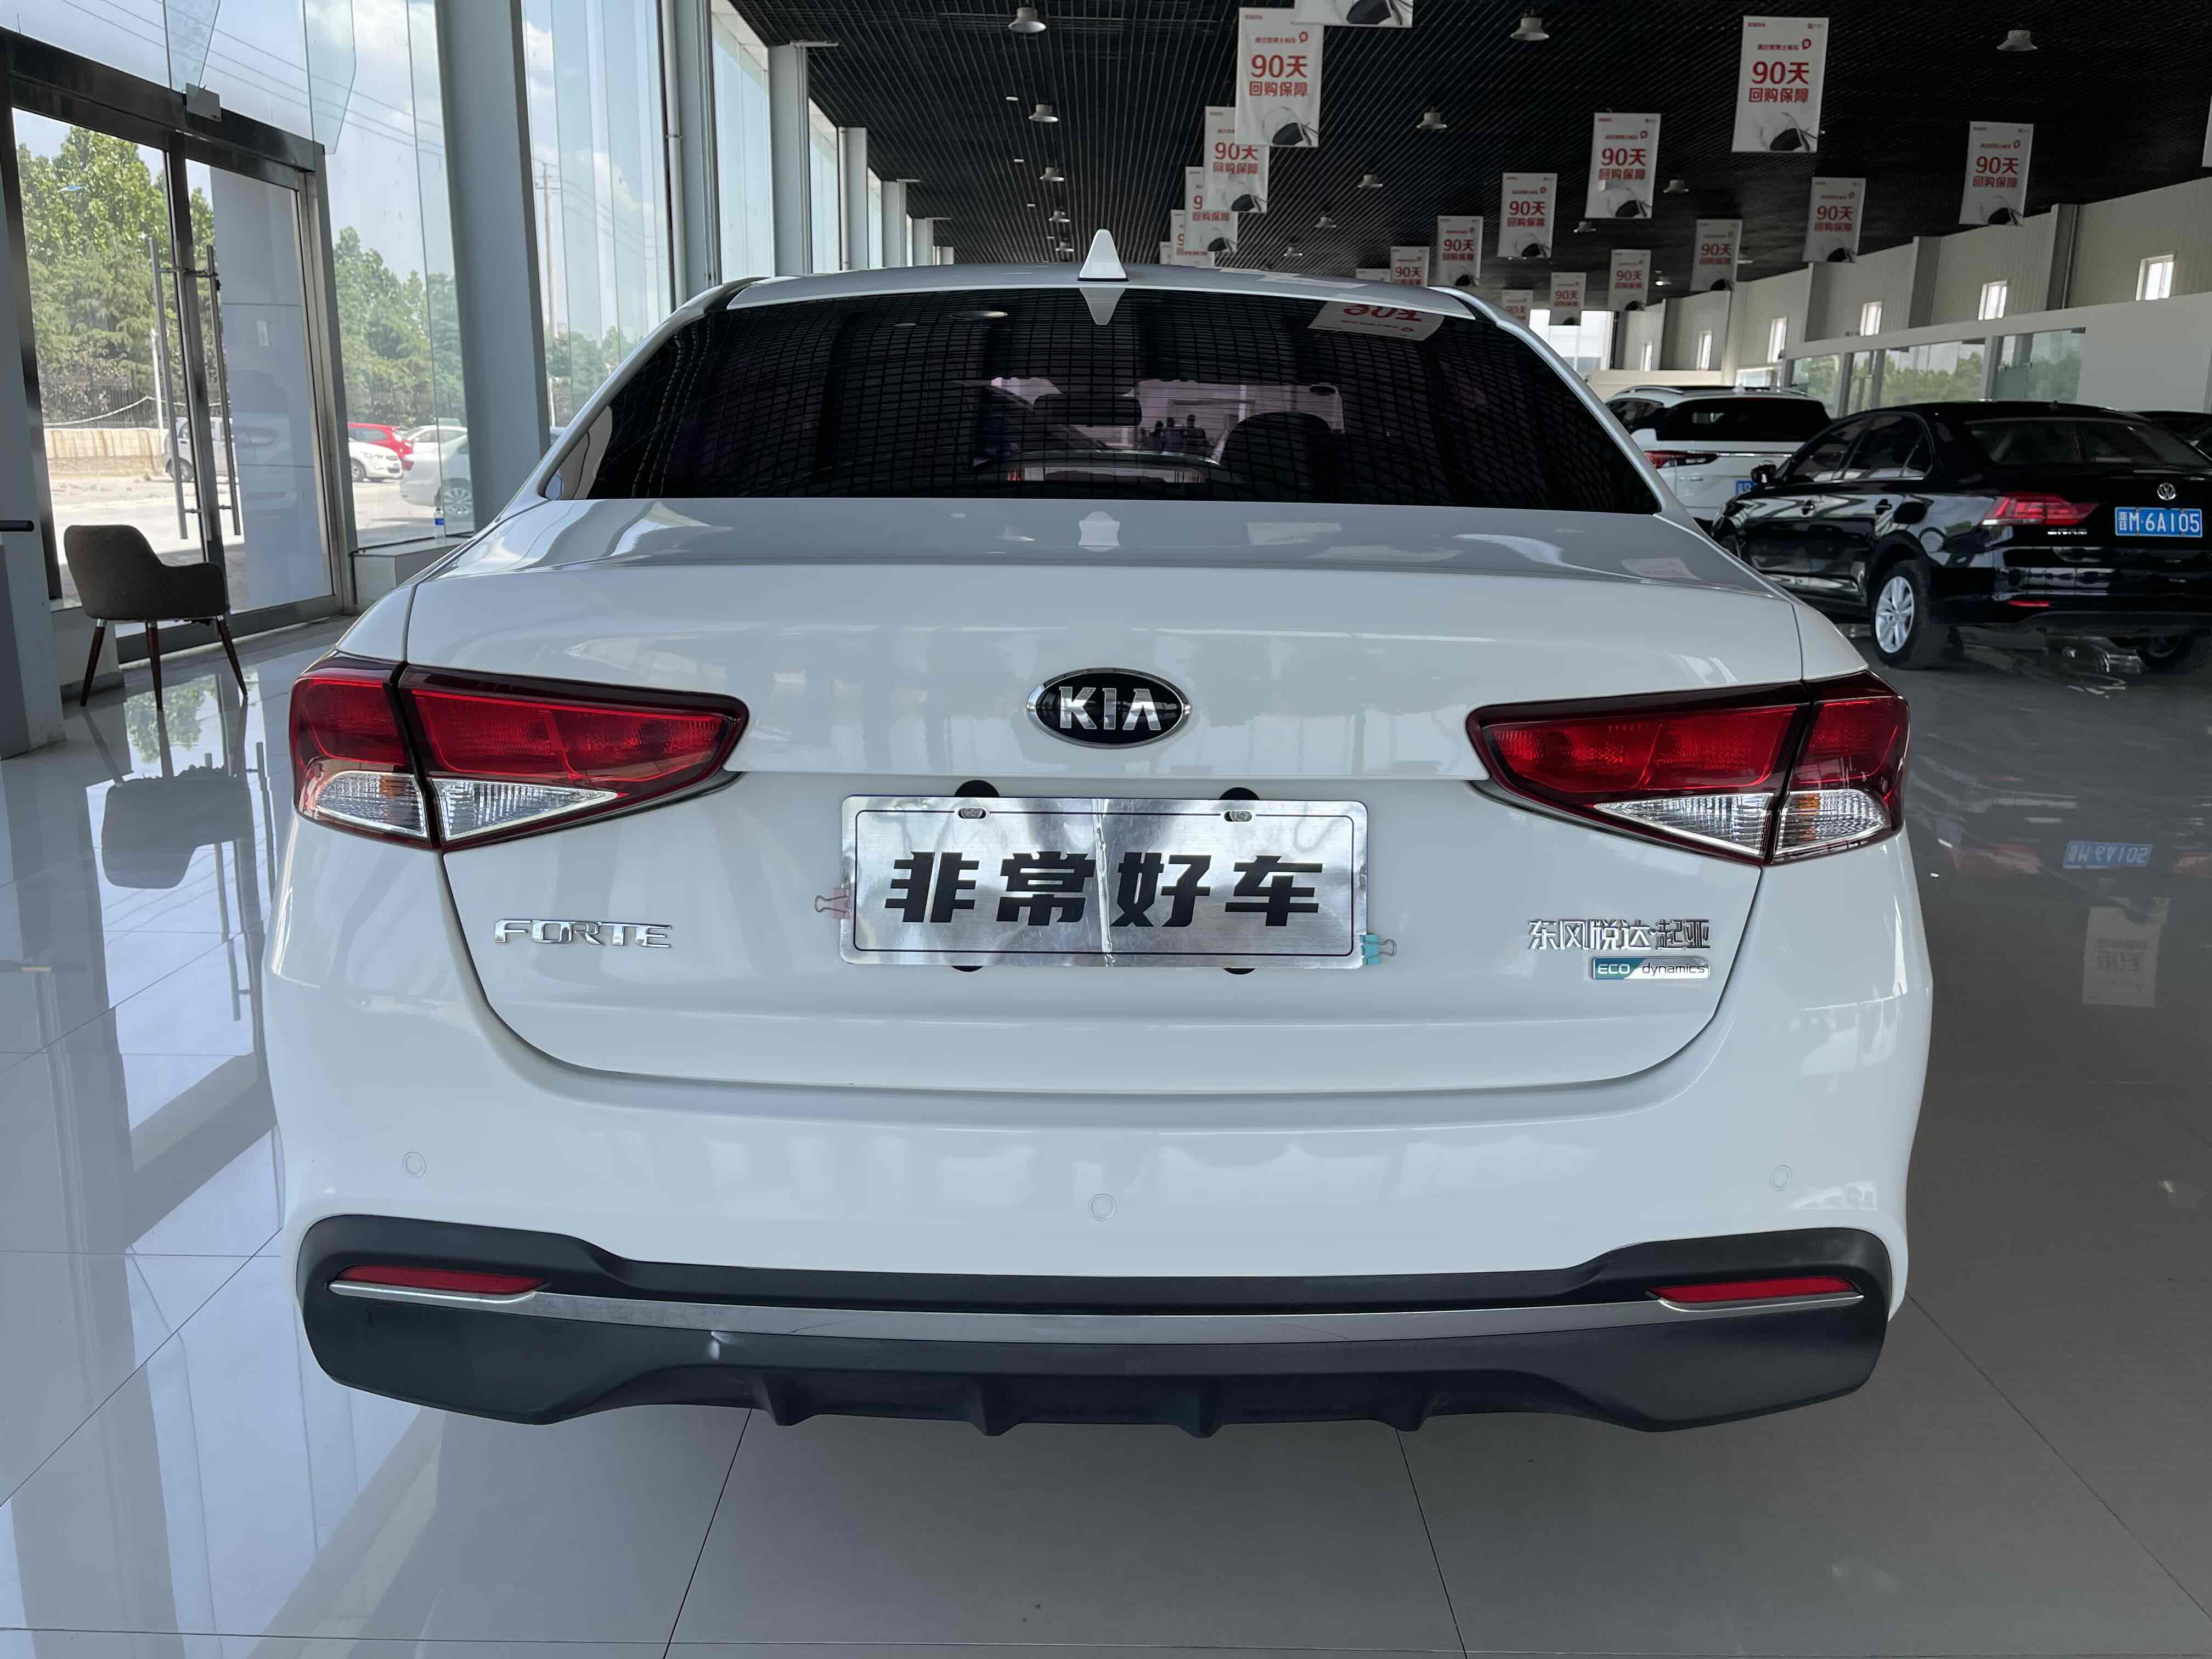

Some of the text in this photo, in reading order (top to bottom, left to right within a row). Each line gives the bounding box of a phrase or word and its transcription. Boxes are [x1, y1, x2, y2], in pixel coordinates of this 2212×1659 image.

[1251, 54, 1308, 78] 90天
[1752, 61, 1809, 84] 90天
[1249, 81, 1308, 97] 回购保障
[1749, 88, 1809, 103] 回购保障
[1215, 142, 1259, 160] 90天
[1601, 148, 1646, 166] 90天
[1976, 156, 2019, 175] 90天
[1510, 201, 1545, 216] 90天
[1817, 206, 1853, 221] 90天
[1444, 239, 1475, 251] 90天
[1702, 243, 1730, 256] 90天
[1395, 267, 1422, 277] 90天
[1616, 270, 1642, 281] 90天
[1555, 290, 1578, 300] 90天
[1059, 686, 1161, 731] KIA
[885, 851, 1323, 927] 非常好车
[494, 919, 672, 949] FORTE
[1597, 963, 1706, 977] ECO dynamics
